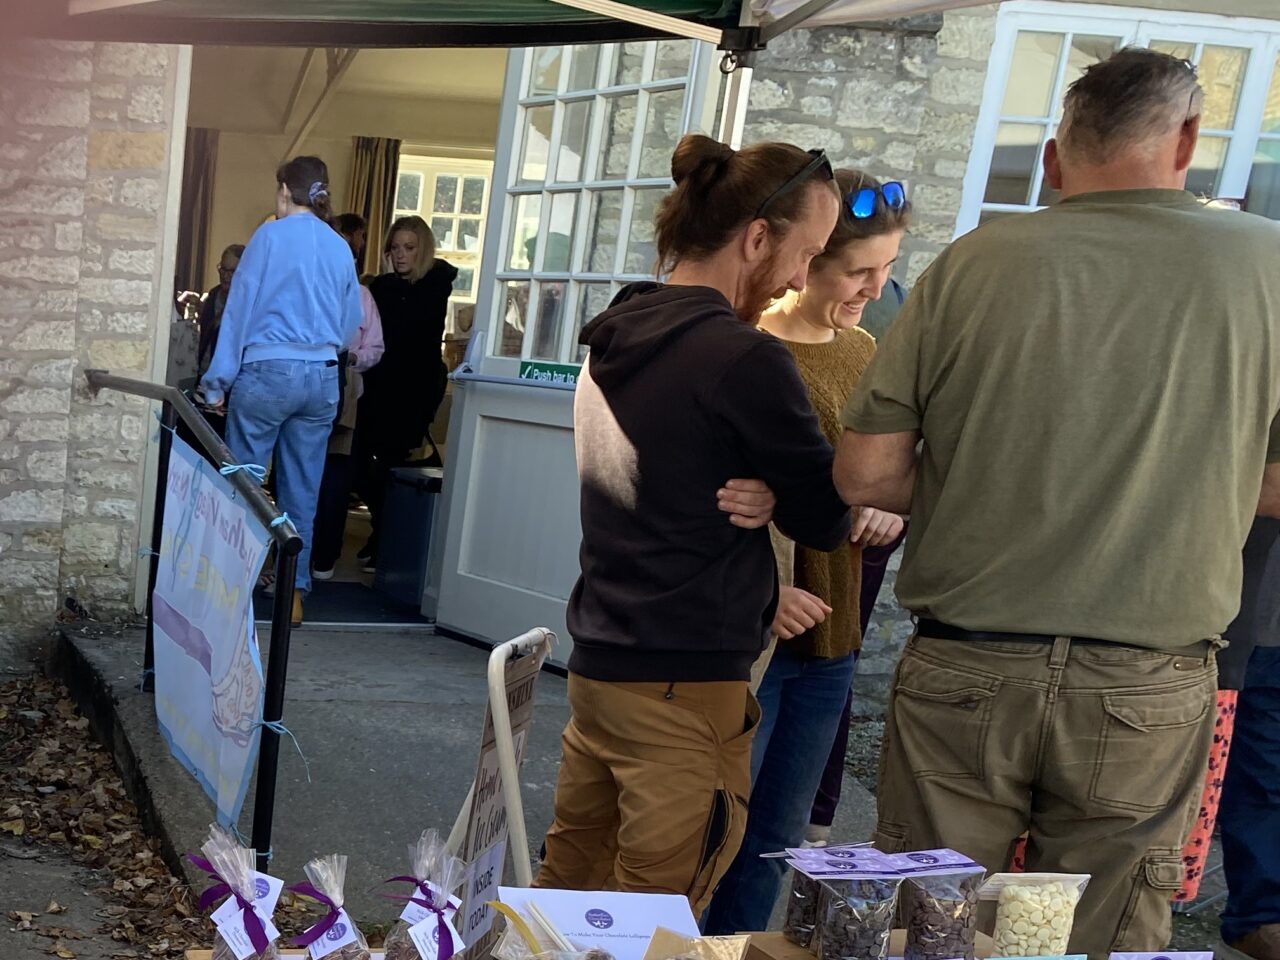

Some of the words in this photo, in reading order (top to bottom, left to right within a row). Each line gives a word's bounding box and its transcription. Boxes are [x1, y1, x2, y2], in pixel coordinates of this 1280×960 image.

[534, 369, 551, 381] Push
[553, 371, 566, 382] bar
[473, 866, 494, 898] INSIDE
[469, 902, 489, 933] TODAY
